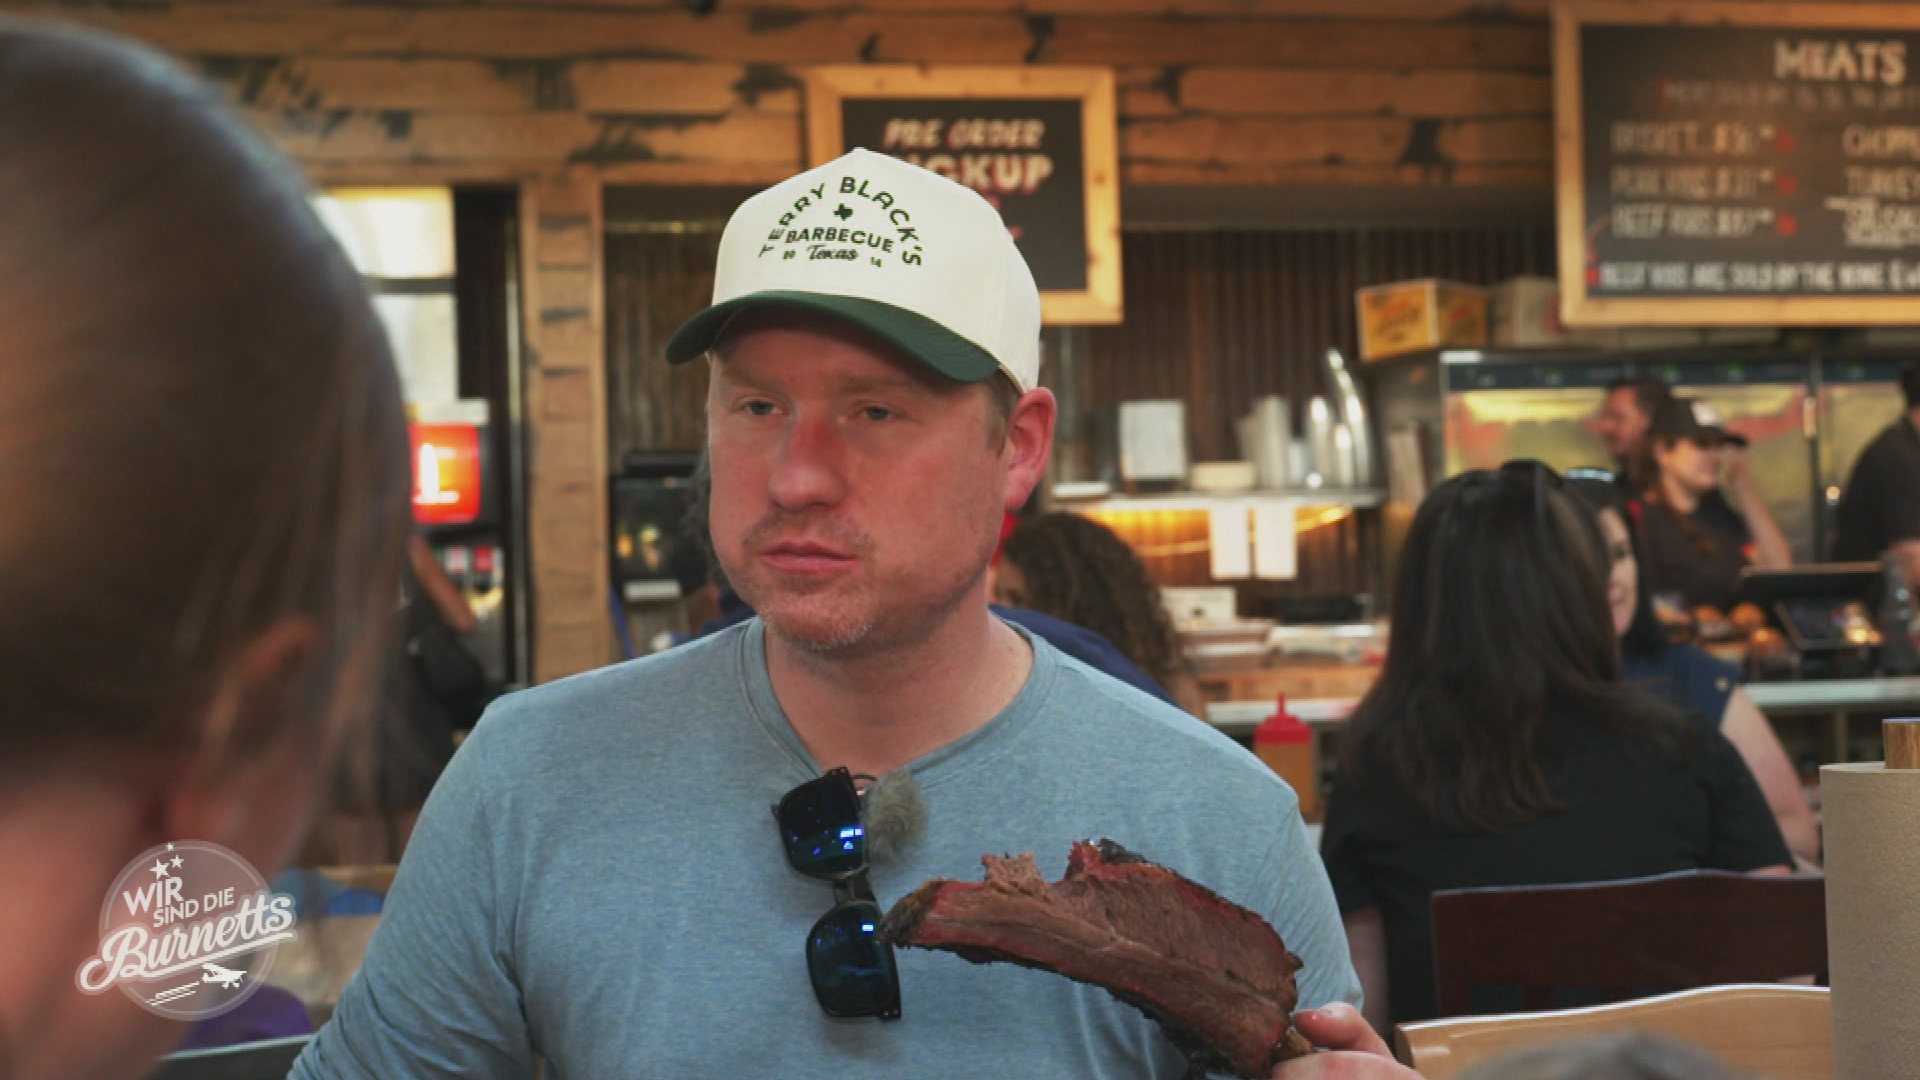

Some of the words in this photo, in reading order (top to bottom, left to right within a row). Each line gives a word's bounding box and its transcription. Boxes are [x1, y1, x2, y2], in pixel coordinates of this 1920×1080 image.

[1774, 40, 1906, 84] MEATS
[883, 118, 942, 148] PRE
[947, 118, 1045, 148] ORDER
[758, 183, 826, 257] TERRY
[839, 176, 923, 266] BLACK'S
[785, 227, 894, 253] BARBECUE
[805, 244, 859, 261] Texas
